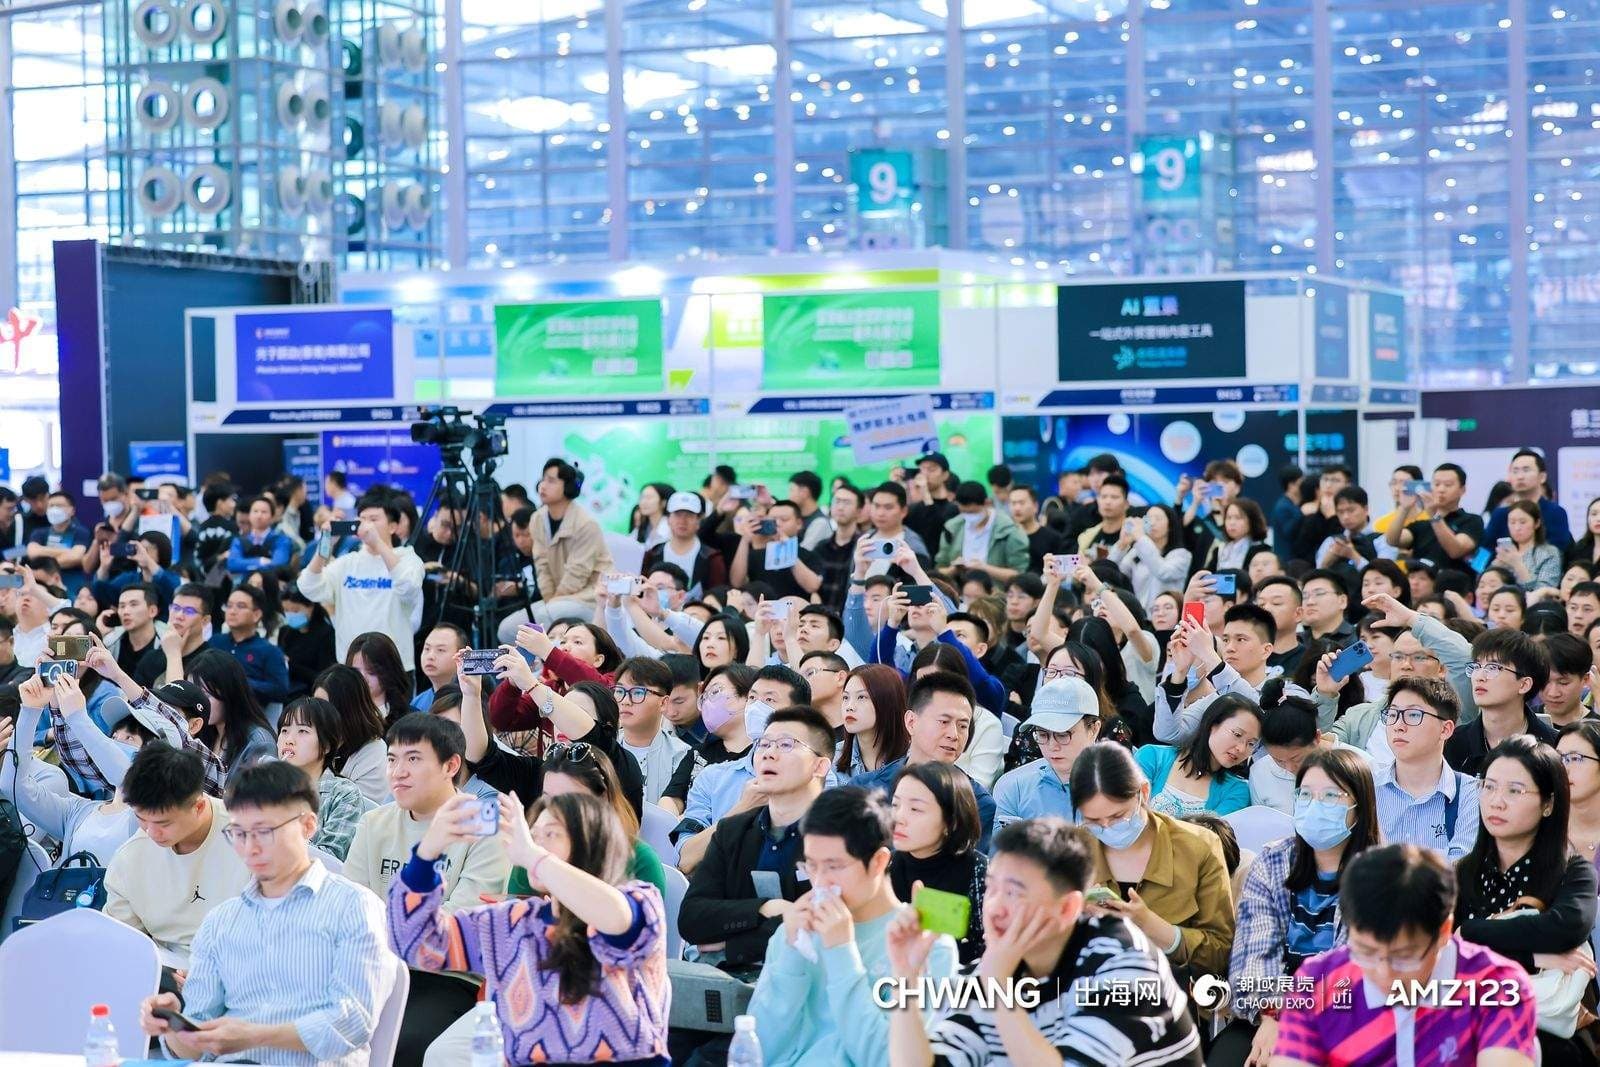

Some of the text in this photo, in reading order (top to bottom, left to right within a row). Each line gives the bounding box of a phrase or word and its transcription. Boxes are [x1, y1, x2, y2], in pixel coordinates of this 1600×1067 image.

[869, 162, 897, 204] 9
[1156, 148, 1186, 191] 9
[1120, 297, 1141, 317] AI
